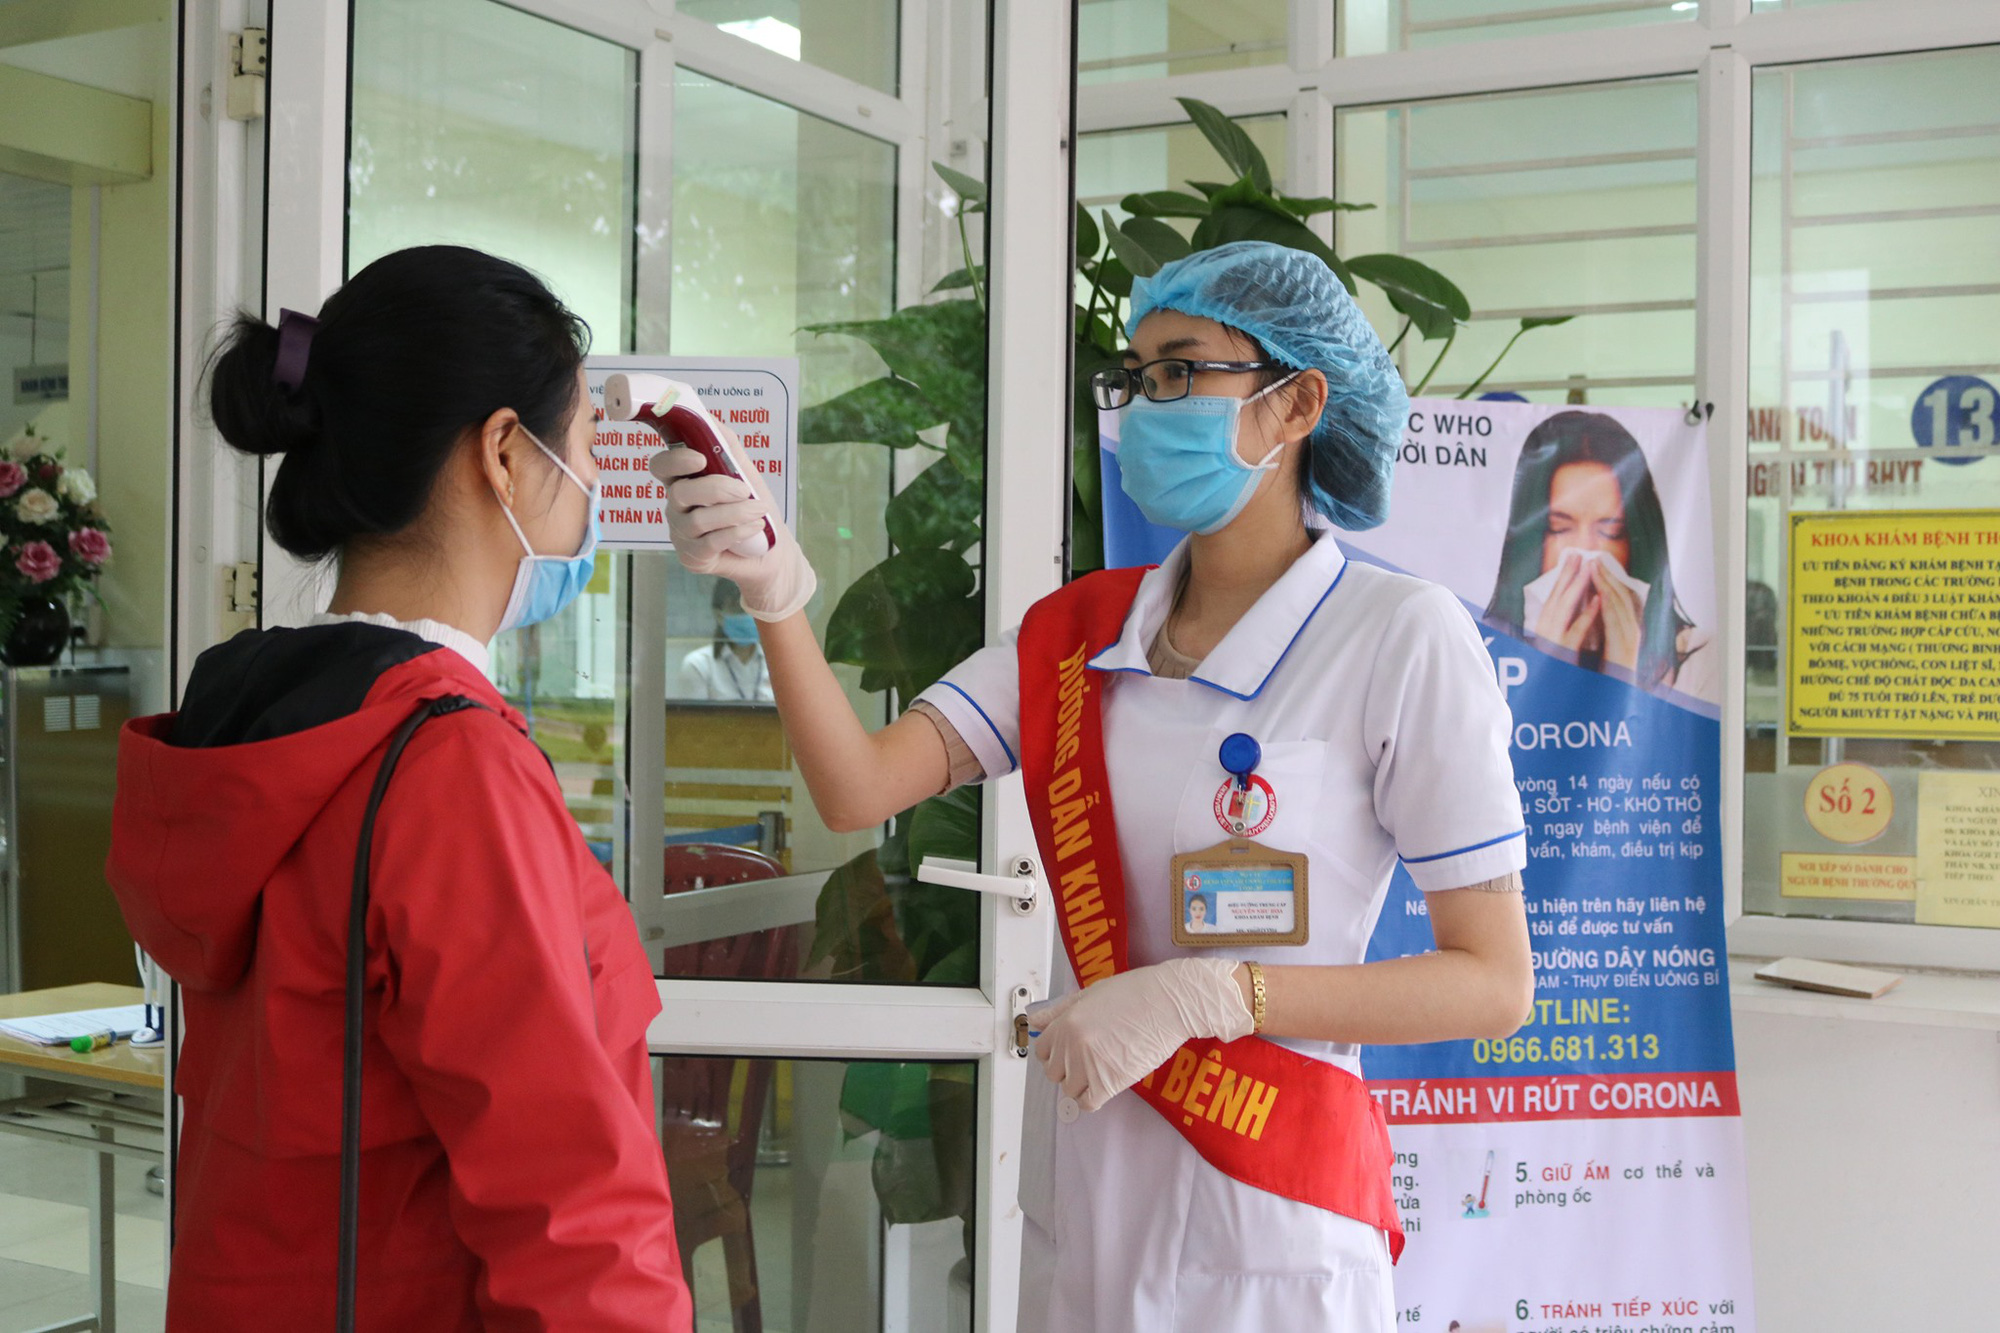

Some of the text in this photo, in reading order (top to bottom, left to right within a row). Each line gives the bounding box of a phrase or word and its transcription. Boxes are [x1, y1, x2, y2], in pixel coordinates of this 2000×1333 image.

[697, 384, 763, 396] ĐIỂN UÔNG BÍ
[730, 407, 769, 423] NGƯỜI
[1434, 413, 1492, 436] WHO
[1923, 386, 1995, 449] 13
[593, 430, 665, 450] GƯỜI BỆNH,
[744, 431, 770, 448] ĐẾN
[595, 455, 629, 471] HÁCH
[1436, 441, 1487, 467] DÂN
[769, 460, 781, 476] BỊ
[601, 485, 632, 498] RANG
[636, 480, 653, 499] ĐỂ
[609, 507, 642, 524] THÂN
[647, 508, 663, 524] VÀ
[1812, 528, 1969, 549] KHOA KHÁM BỆNH
[1823, 559, 1850, 571] TIÊN
[1910, 558, 1947, 570] KHÁM
[1951, 559, 1983, 572] BỆNH
[1834, 576, 1866, 589] BỆNH
[1870, 576, 1911, 587] TRONG
[1914, 574, 1940, 587] CÁC
[1875, 607, 1911, 620] KHÁM
[1915, 609, 1947, 622] BỆNH
[1921, 660, 1947, 670] CON
[1960, 676, 1976, 687] DA
[1509, 720, 1632, 750] ORONA
[1517, 772, 1700, 795] vòng 14 ngày nếu có
[1535, 791, 1571, 814] SỐT
[1587, 796, 1612, 812] HO
[1624, 793, 1661, 812] KHÓ
[1663, 791, 1702, 812] THỞ
[1819, 778, 1877, 814] Số 2
[1048, 641, 1117, 988] HƯỚNG DẪN KHÁM
[1544, 823, 1584, 839] ngay
[1594, 819, 1629, 838] bệnh
[1639, 819, 1671, 837] viện
[1682, 815, 1702, 834] để
[1530, 839, 1704, 860] vấn, khám, điều trị kịp
[1543, 897, 1578, 916] hiện
[1582, 897, 1611, 913] trên
[1616, 897, 1645, 916] hãy
[1650, 896, 1680, 912] liên
[1684, 896, 1706, 915] hệ
[1532, 916, 1673, 937] tôi để được tư vấn
[1532, 944, 1715, 969] ĐƯỜNG DÂY NÓNG
[1572, 967, 1719, 990] THỤY ĐIỂN UÔNG BÍ
[1473, 1033, 1660, 1064] 0966.681.313
[1160, 1047, 1279, 1141] BỆNH
[1370, 1077, 1722, 1116] TRÁNH VI RÚT CORONA
[1515, 1159, 1714, 1182] 5. GIỮ ẤM cơ thể và
[1515, 1186, 1592, 1208] phòng ốc
[1406, 1304, 1421, 1322] tế
[1515, 1295, 1734, 1320] 6. TRÁNH TIẾP XÚC với
